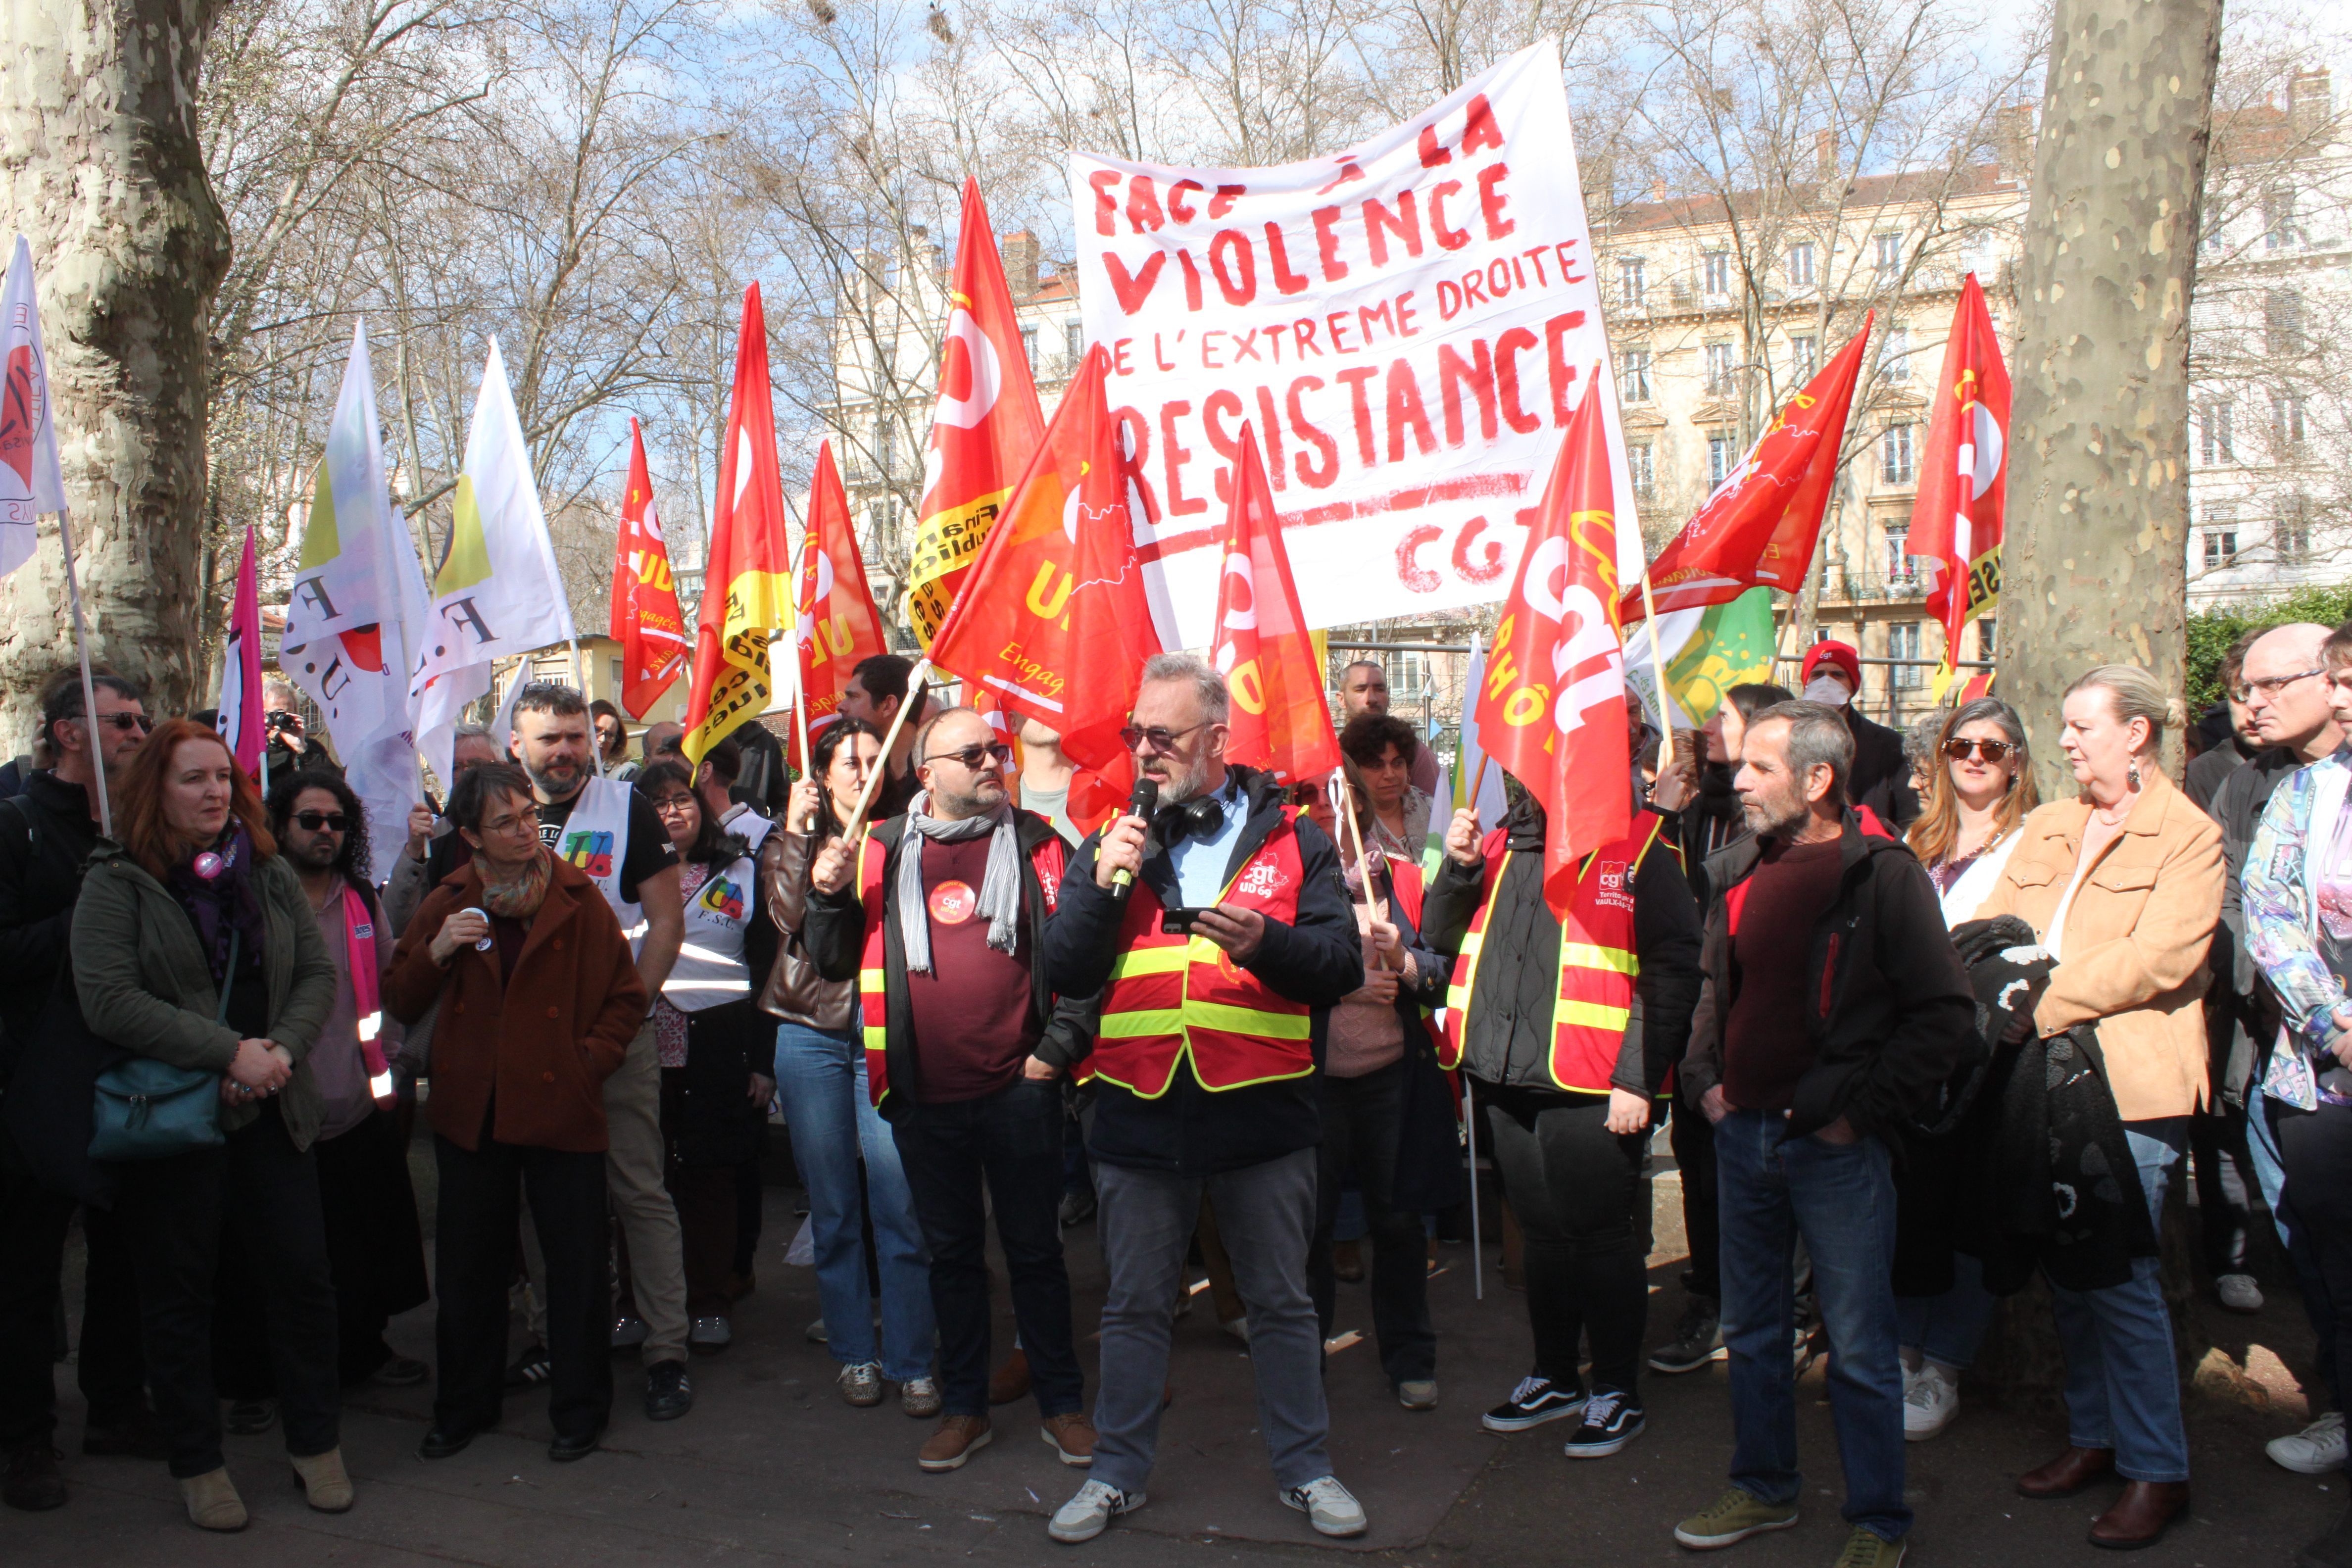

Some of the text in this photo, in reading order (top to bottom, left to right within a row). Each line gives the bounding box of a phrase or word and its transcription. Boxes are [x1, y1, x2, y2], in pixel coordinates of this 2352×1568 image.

[1089, 170, 1247, 237] FACE
[1418, 93, 1505, 168] LA
[1102, 162, 1516, 316] VIOLENCE
[1437, 240, 1587, 321] DROITE
[1108, 310, 1587, 525] RESISTANCE
[998, 641, 1064, 698] Engag
[942, 897, 962, 909] cgt
[1239, 882, 1273, 899] UD 69
[1600, 873, 1624, 888] cgt
[697, 910, 734, 931] F.S.U.
